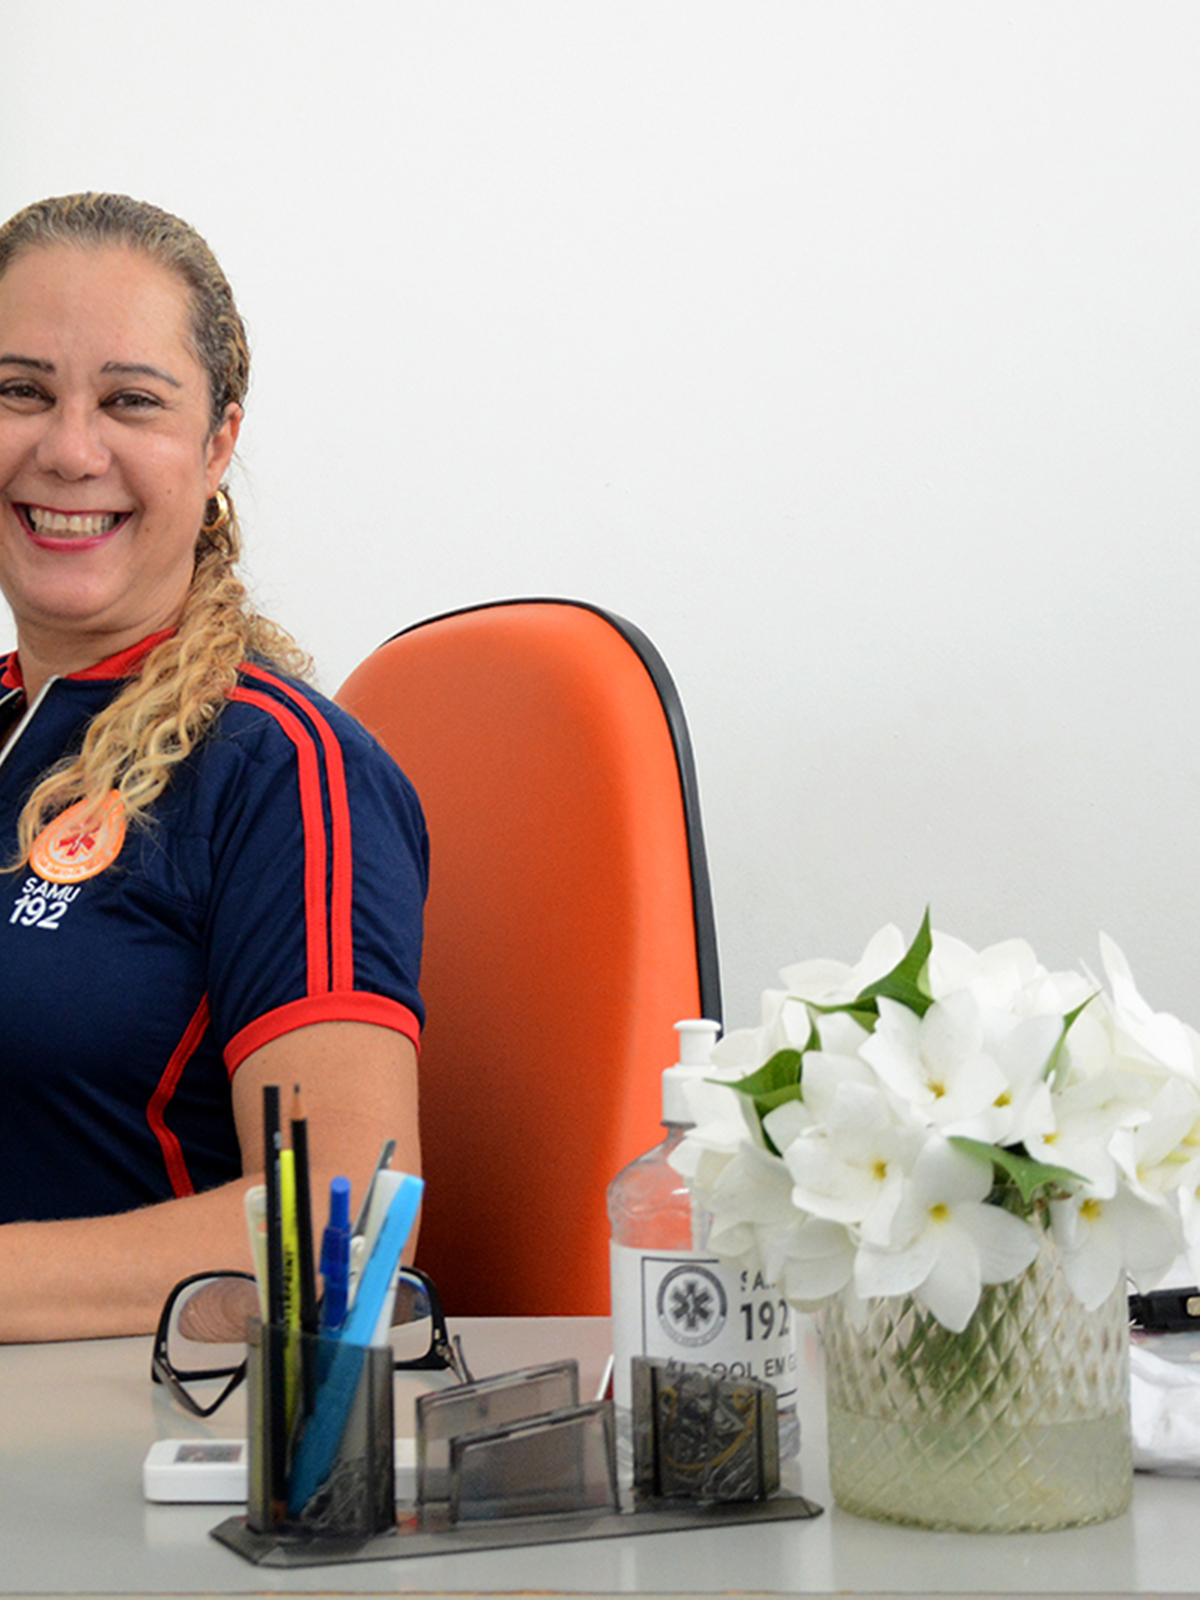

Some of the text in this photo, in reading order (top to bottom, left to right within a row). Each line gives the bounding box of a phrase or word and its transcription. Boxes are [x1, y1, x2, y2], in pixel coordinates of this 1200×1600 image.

[22, 877, 82, 903] SAMU
[9, 894, 68, 930] 192
[740, 1299, 790, 1341] 192
